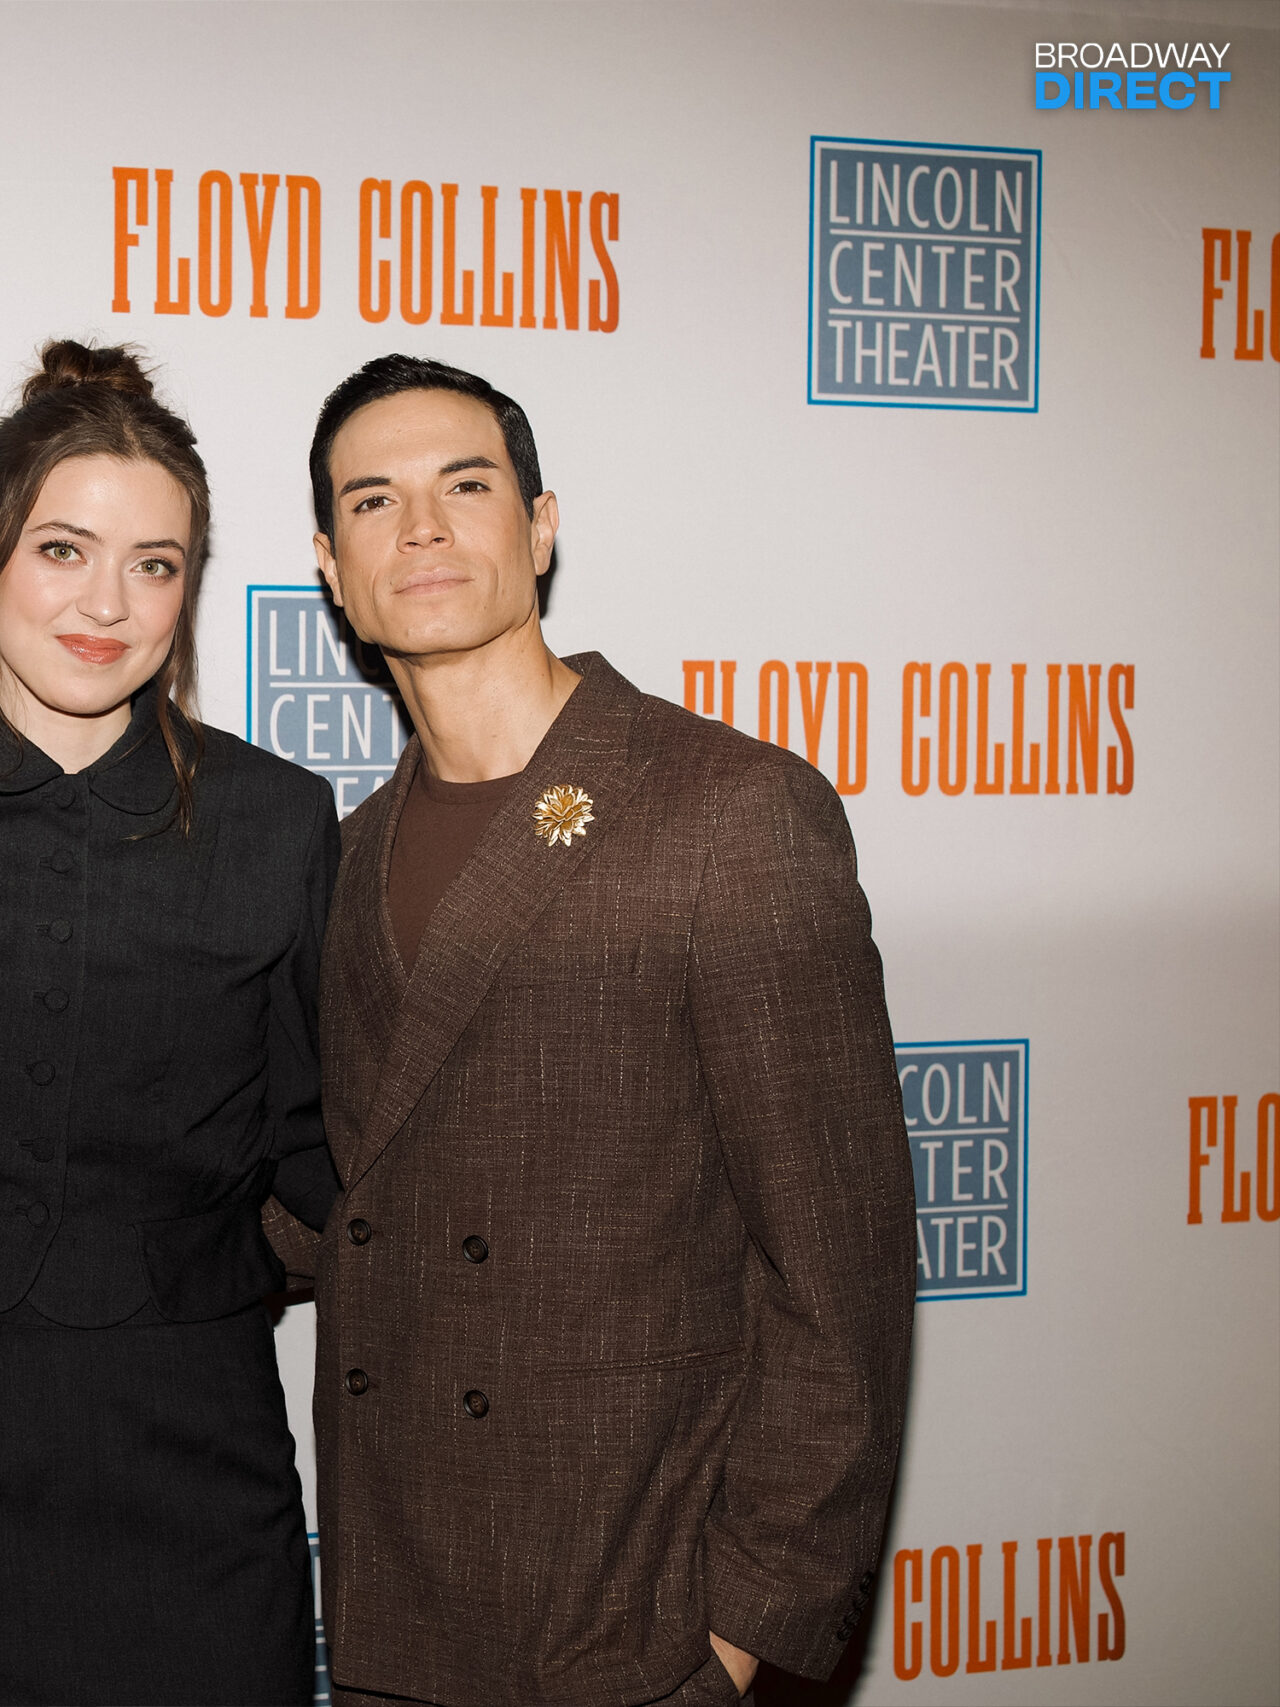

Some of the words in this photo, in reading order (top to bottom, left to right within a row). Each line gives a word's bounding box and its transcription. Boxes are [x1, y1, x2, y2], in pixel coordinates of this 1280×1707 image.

[829, 159, 1023, 234] LINCOLN
[112, 166, 322, 320] FLOYD
[358, 177, 620, 333] COLLINS
[828, 240, 1021, 313] CENTER
[827, 319, 1020, 391] THEATER
[270, 694, 402, 760] CENT
[901, 661, 1135, 796] COLLINS
[898, 1061, 1010, 1127] COLN
[920, 1138, 1009, 1203] TER
[1187, 1092, 1280, 1225] FLO
[916, 1215, 1008, 1280] ATER
[893, 1531, 1126, 1681] COLLINS
